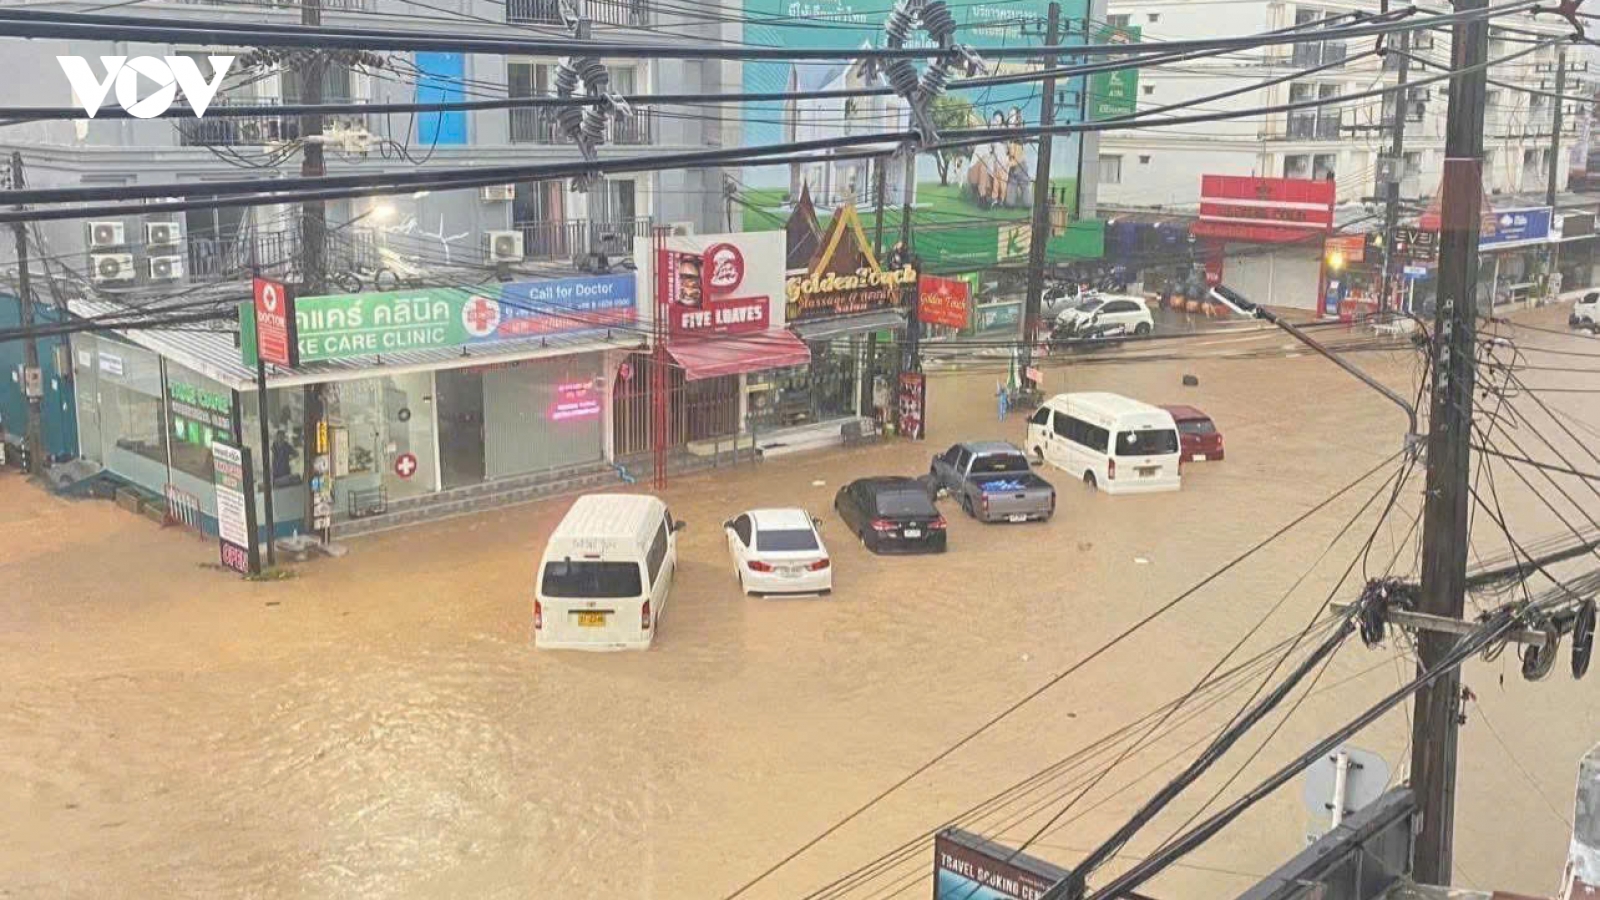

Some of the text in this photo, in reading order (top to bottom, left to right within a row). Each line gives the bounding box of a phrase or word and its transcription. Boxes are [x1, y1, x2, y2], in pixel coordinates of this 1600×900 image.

[530, 282, 613, 301] Call for Doctor
[786, 263, 917, 302] Golden Touch
[681, 306, 763, 329] FIVE LOAVES
[324, 332, 378, 351] CARE
[383, 327, 445, 347] CLINIC
[941, 852, 975, 879] TRAVEL
